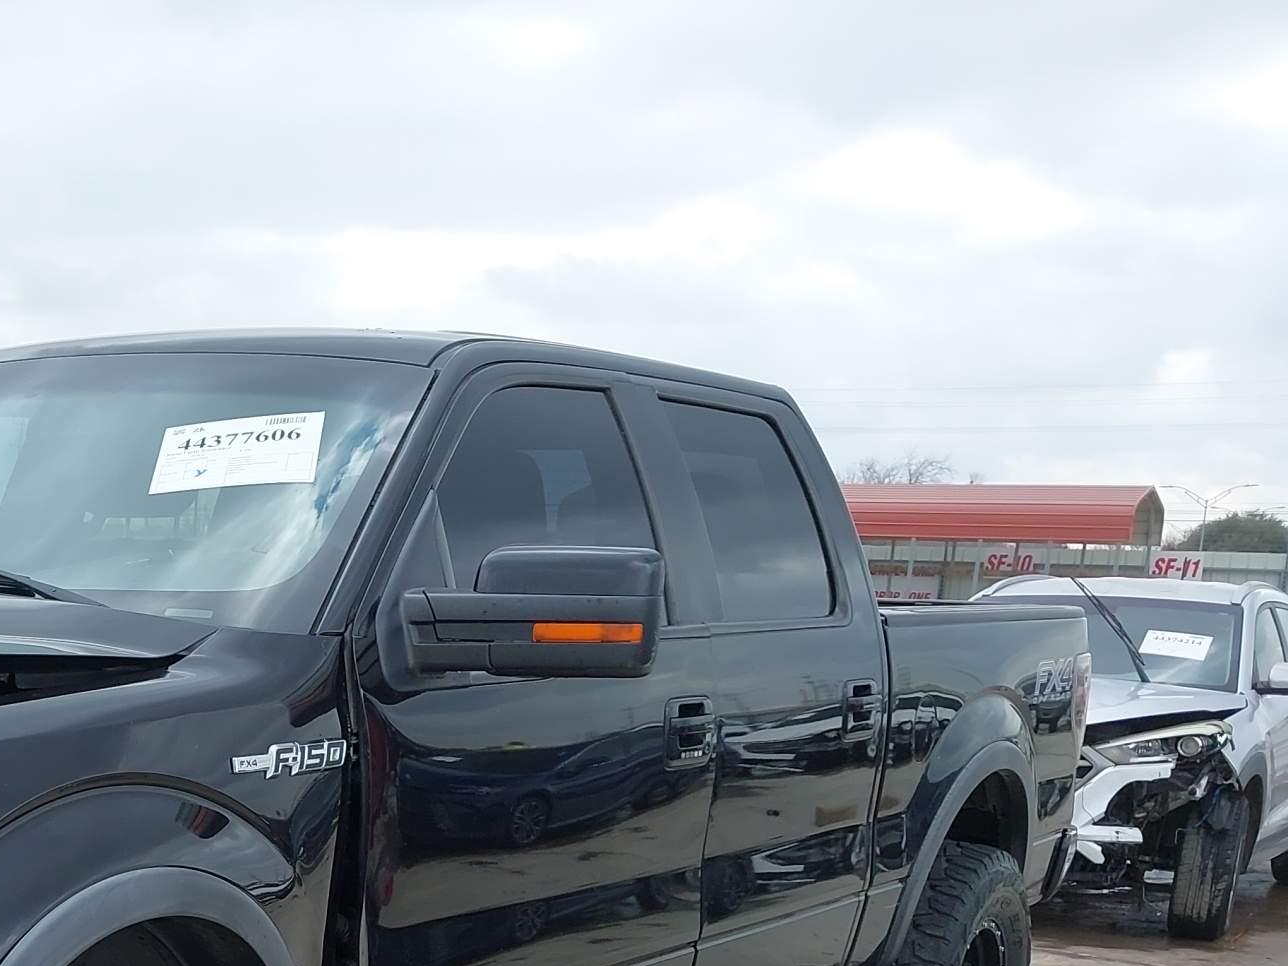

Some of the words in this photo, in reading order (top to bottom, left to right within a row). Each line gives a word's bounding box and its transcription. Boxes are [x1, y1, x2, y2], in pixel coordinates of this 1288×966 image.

[178, 428, 301, 450] 44377606
[986, 554, 1033, 572] SF-10
[1152, 557, 1201, 577] SF-11
[240, 759, 258, 769] FX4
